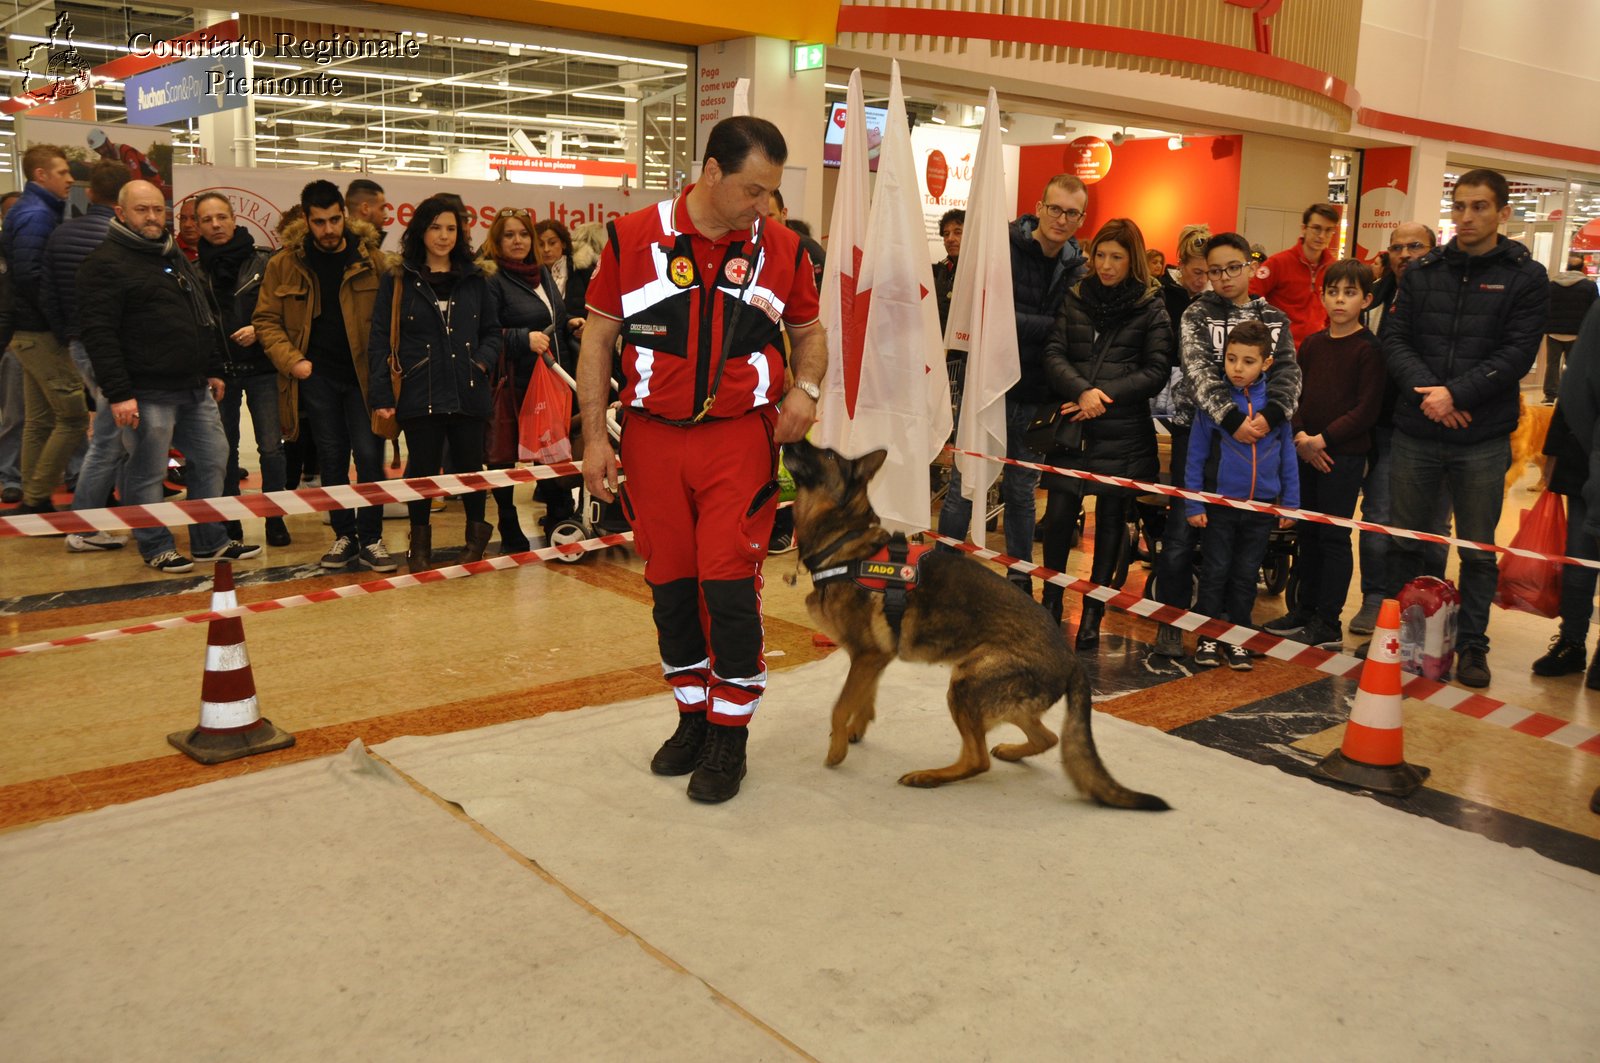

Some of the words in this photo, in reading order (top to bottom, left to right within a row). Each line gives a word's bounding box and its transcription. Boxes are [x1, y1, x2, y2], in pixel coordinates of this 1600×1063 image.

[701, 68, 720, 80] Paga
[700, 82, 720, 92] come
[700, 96, 726, 107] adesso
[700, 108, 719, 124] puoi!
[489, 157, 508, 166] dersi
[1374, 208, 1391, 217] Ben
[867, 563, 895, 575] JADO
